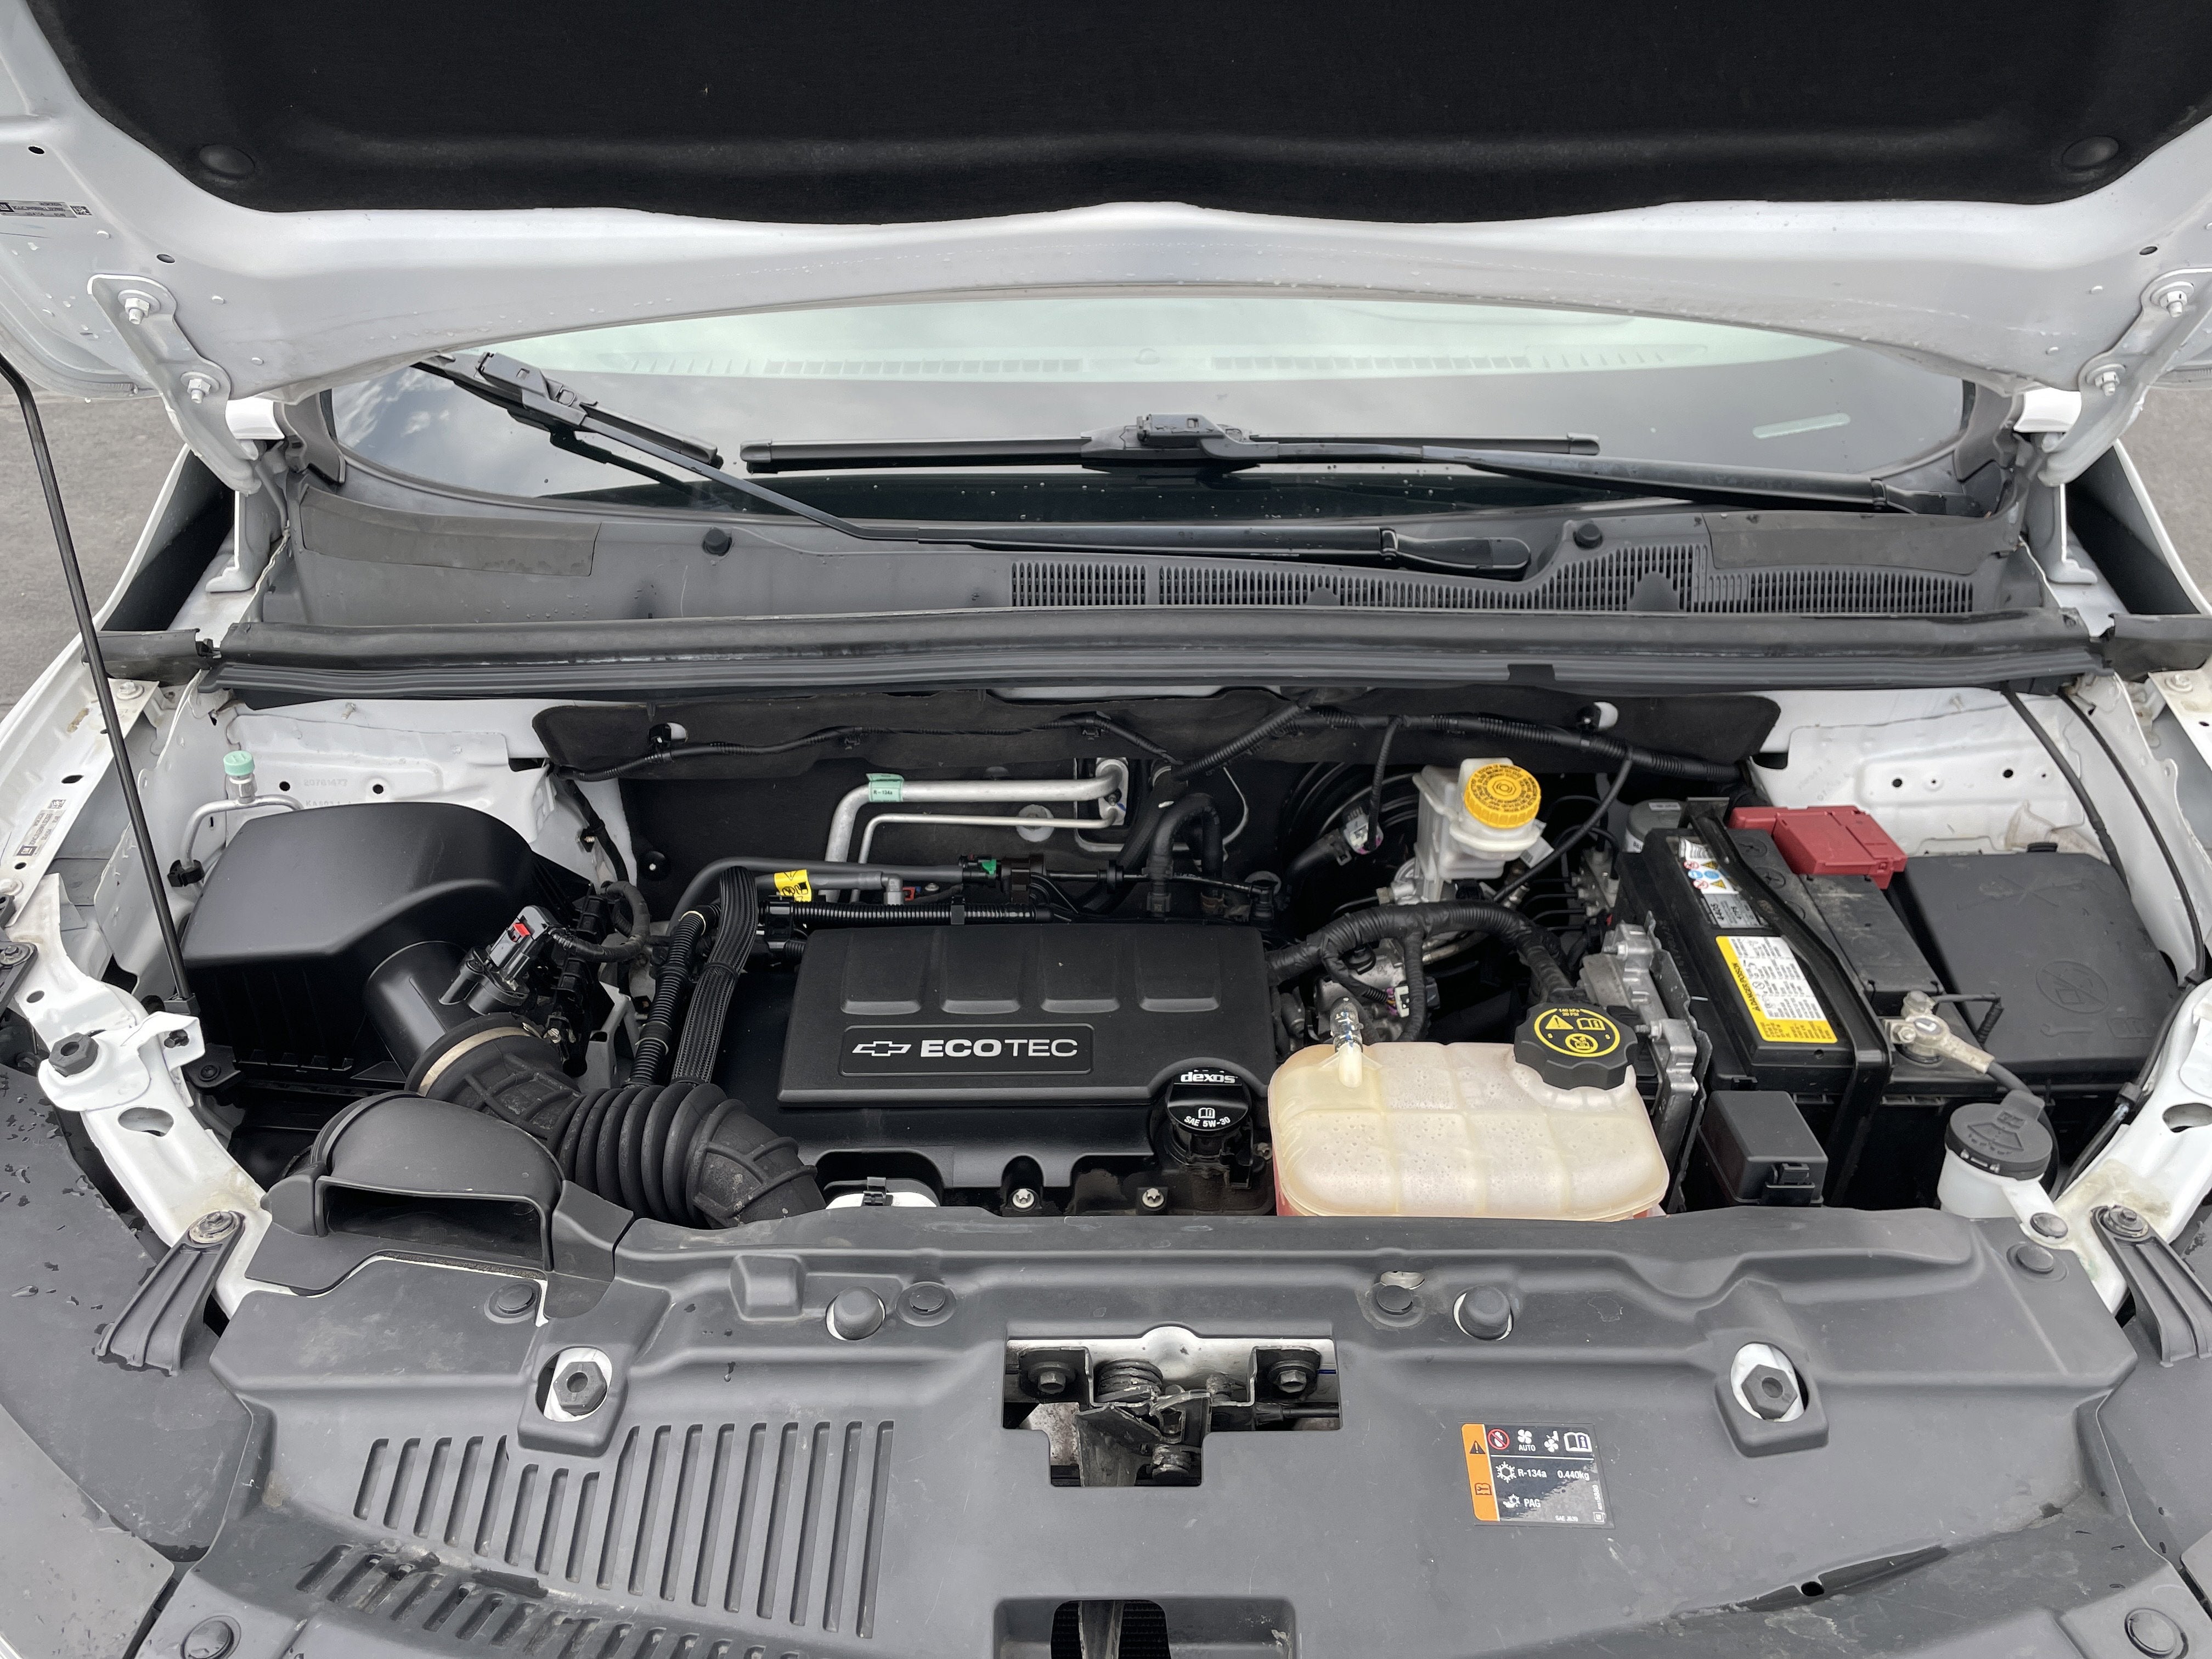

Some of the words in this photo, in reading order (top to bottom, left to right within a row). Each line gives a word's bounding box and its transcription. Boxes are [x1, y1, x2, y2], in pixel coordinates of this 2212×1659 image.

[921, 1039, 1077, 1057] ECOTEC
[1181, 1071, 1235, 1084] dexos
[1184, 1115, 1200, 1126] SAE
[1203, 1116, 1231, 1127] 5W-30
[1517, 1468, 1547, 1479] R-134a
[1557, 1470, 1590, 1481] 0.440kg
[1523, 1498, 1541, 1508] PAG
